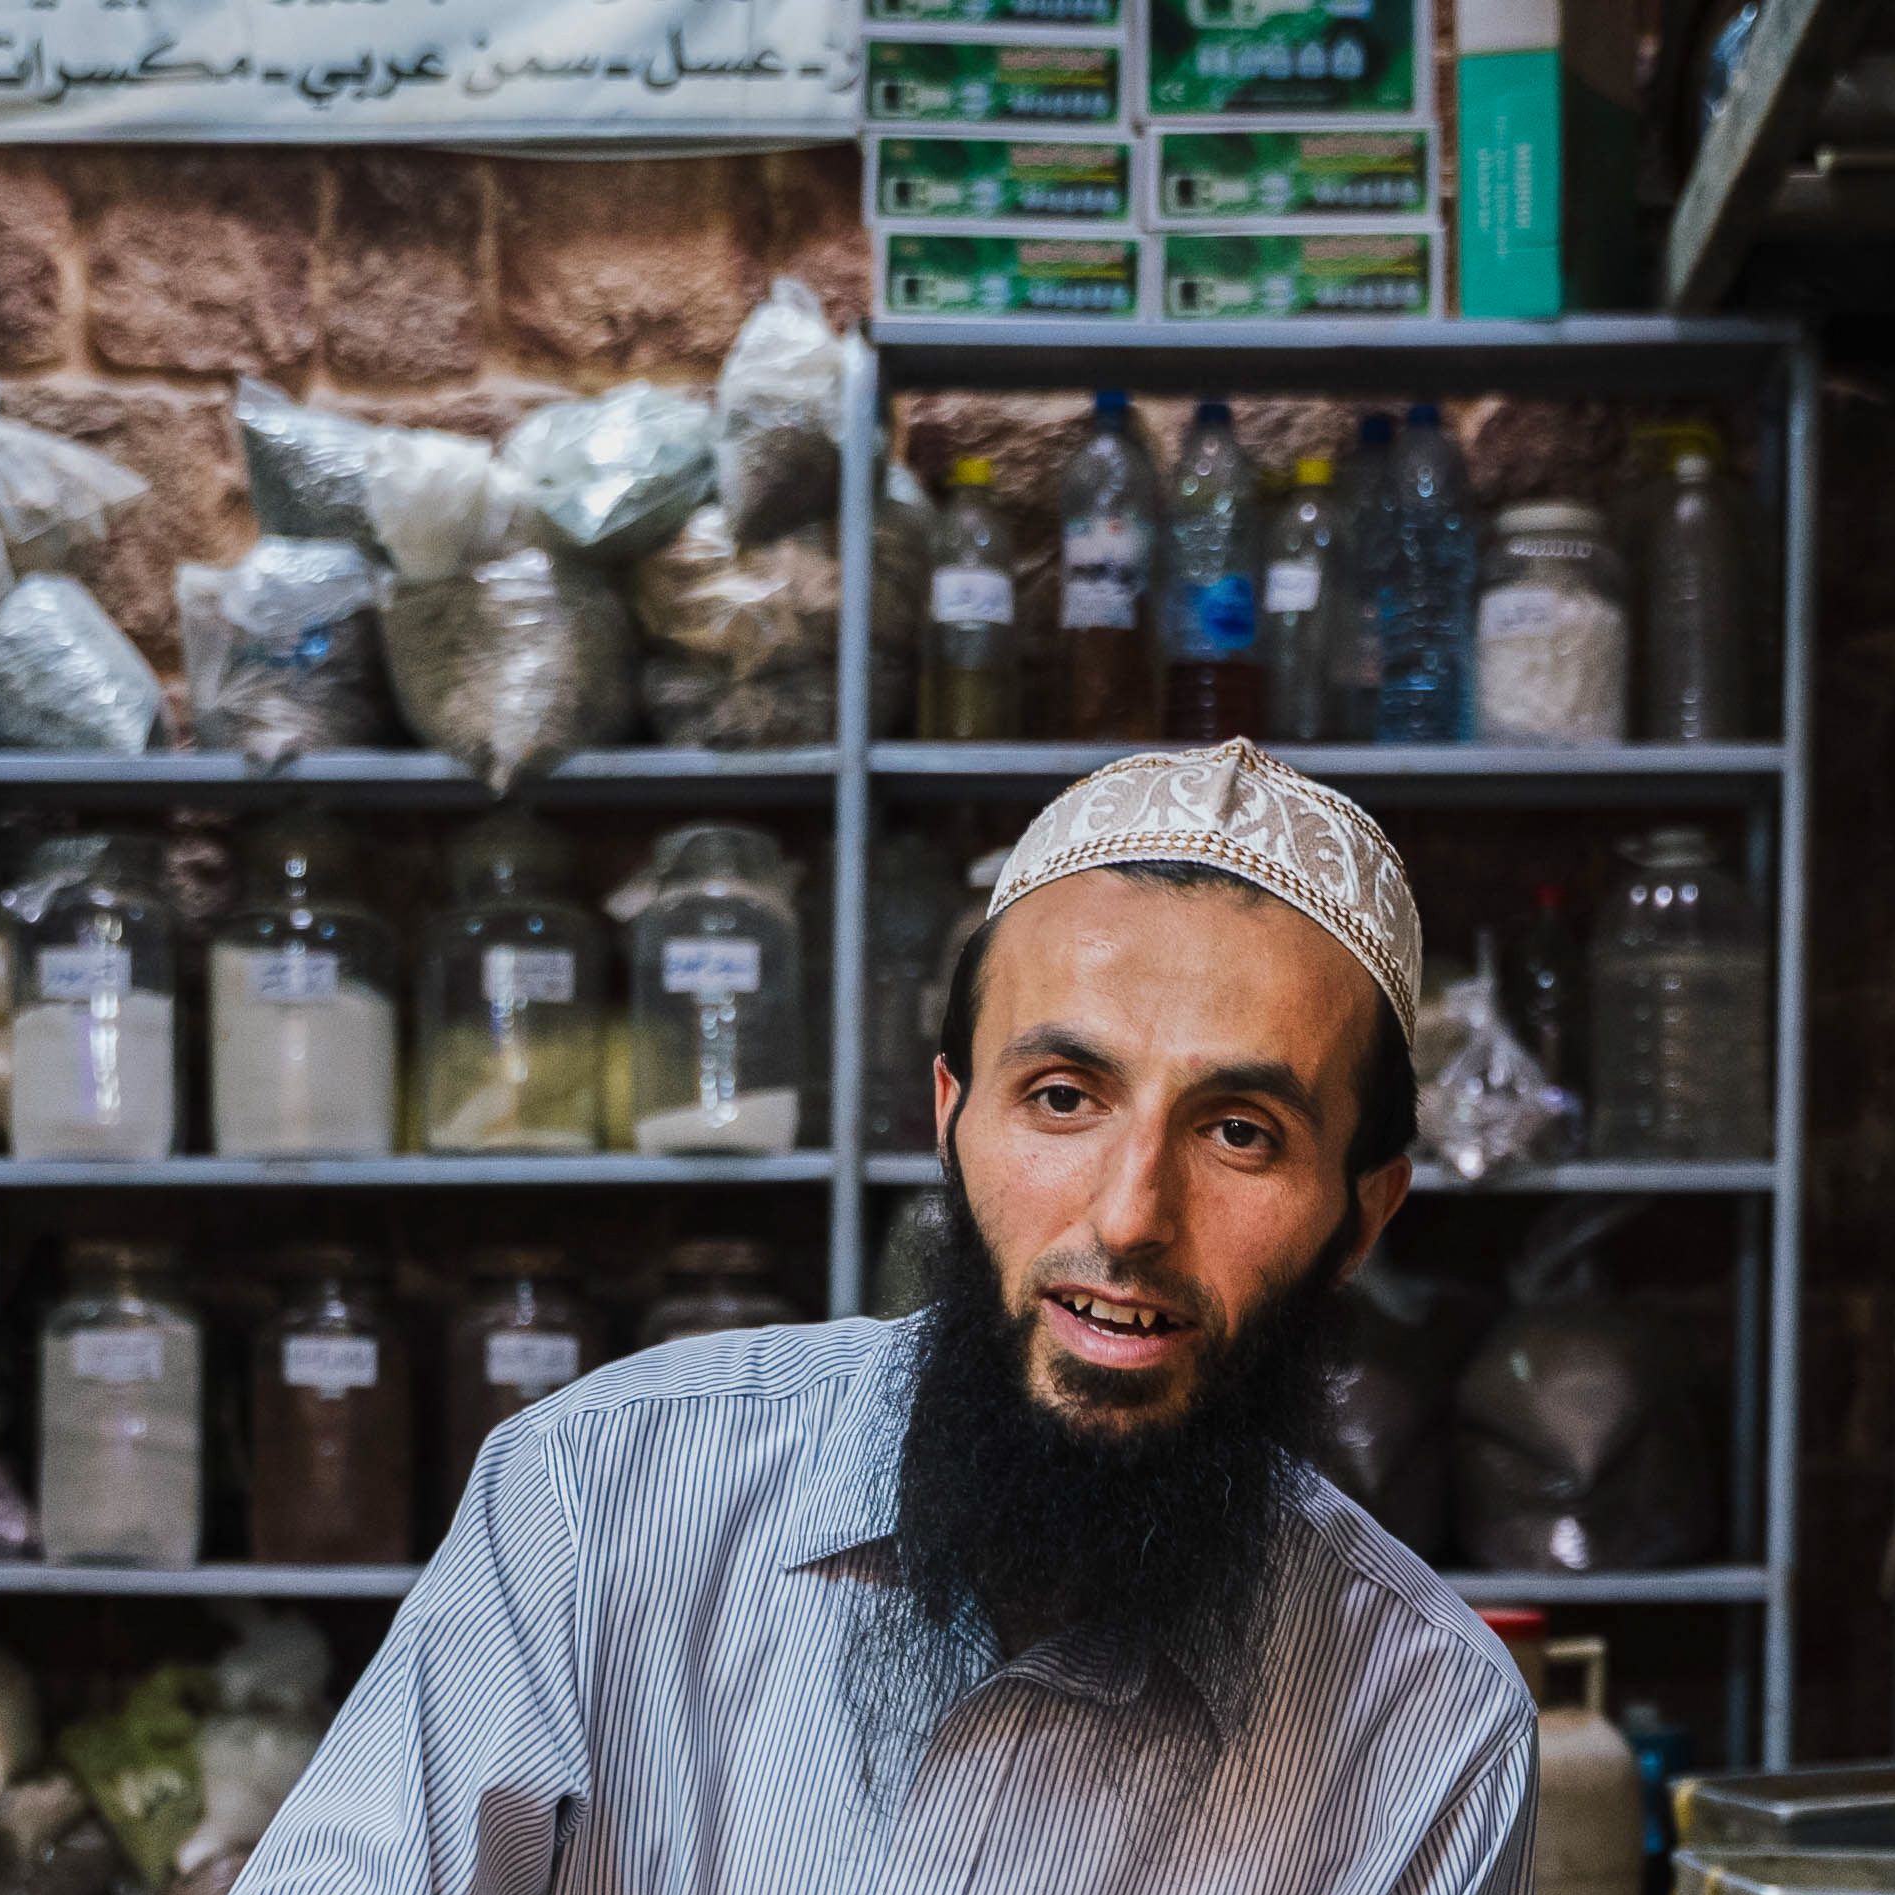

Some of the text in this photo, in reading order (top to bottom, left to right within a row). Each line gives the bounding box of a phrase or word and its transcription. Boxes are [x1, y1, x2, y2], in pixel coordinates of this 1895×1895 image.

[296, 39, 450, 110] عربي
[461, 41, 604, 98] سمن
[643, 22, 786, 94] عسل
